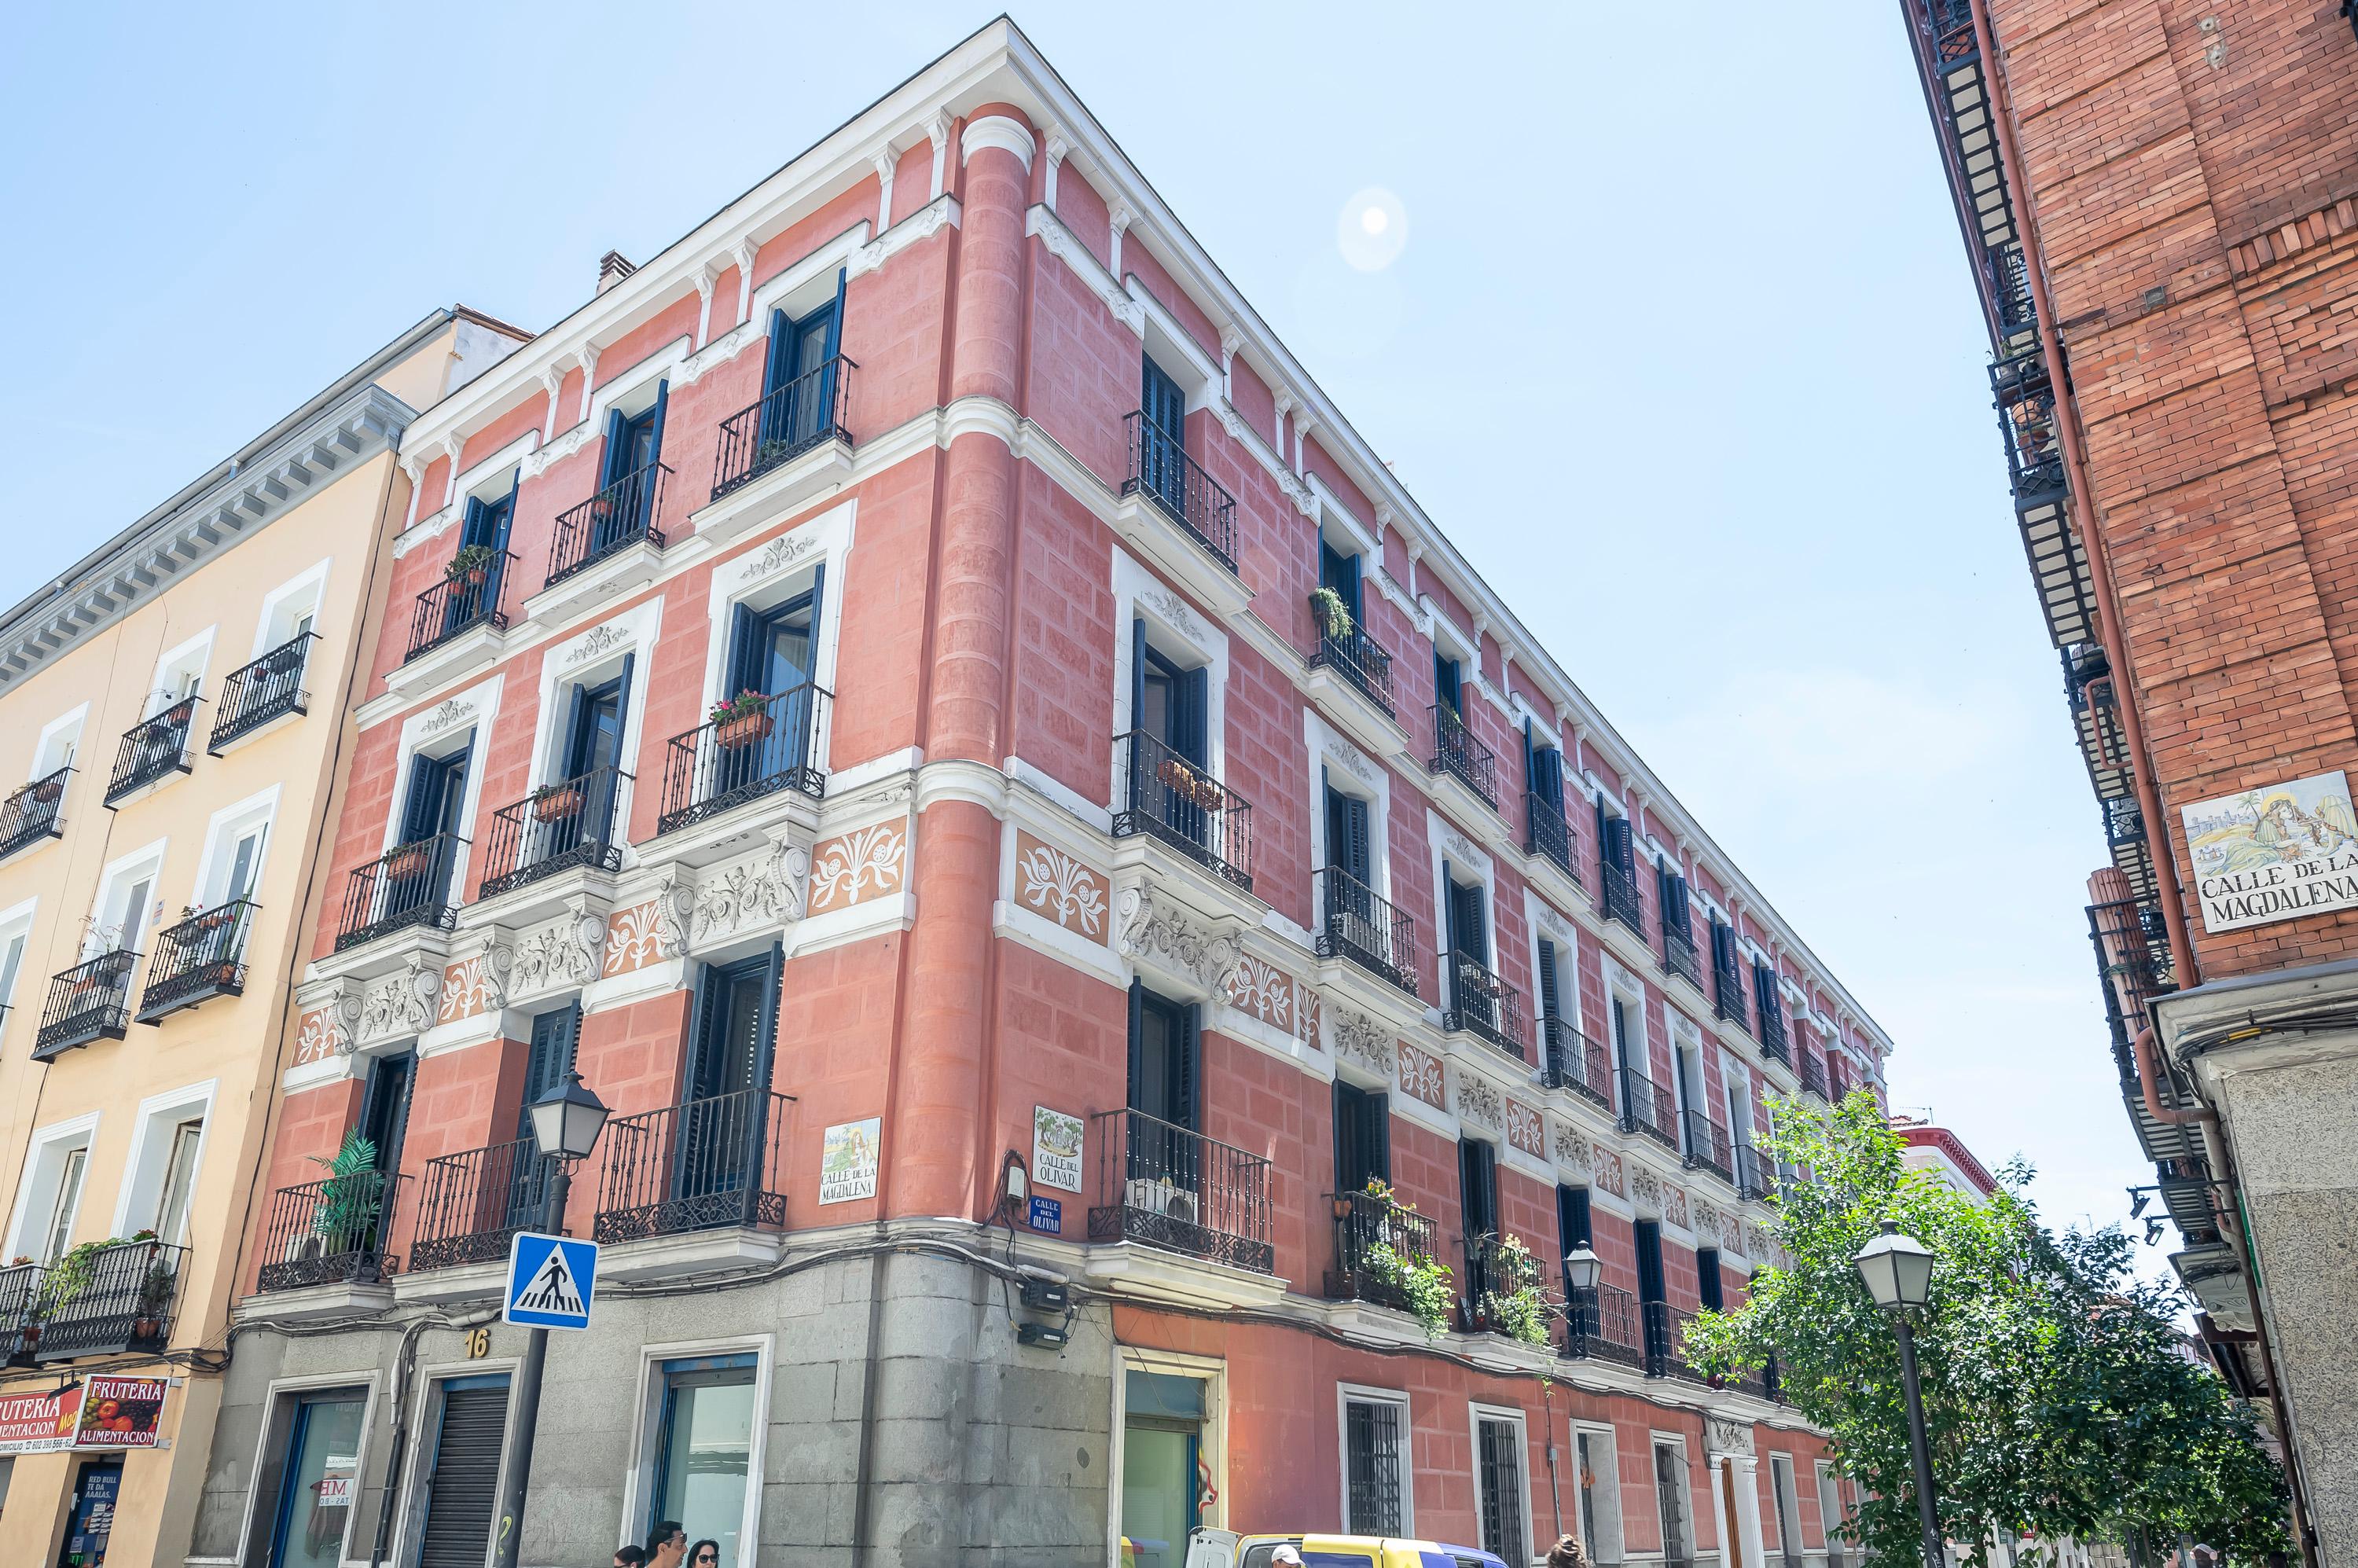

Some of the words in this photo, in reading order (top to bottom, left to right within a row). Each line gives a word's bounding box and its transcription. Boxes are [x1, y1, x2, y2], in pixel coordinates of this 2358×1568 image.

[2202, 866, 2286, 898] CALLE
[2293, 860, 2323, 878] DE
[2327, 854, 2358, 872] LA
[2209, 876, 2358, 924] MAGDALENA
[1040, 1153, 1066, 1170] CALLE
[1067, 1162, 1078, 1172] DEL
[821, 1170, 850, 1185] CALLE
[853, 1170, 862, 1179] DE
[865, 1167, 876, 1177] LA
[1040, 1166, 1076, 1189] OLIVAR
[822, 1180, 872, 1200] MAGDALENA
[1035, 1199, 1058, 1211] CALLE
[1033, 1215, 1060, 1232] OLIVAR
[465, 1328, 488, 1358] 16
[91, 1382, 161, 1401] FRUTERIA
[0, 1396, 61, 1421] UTERIA
[0, 1420, 56, 1438] ENTACION
[79, 1430, 154, 1443] ALIMENTACION
